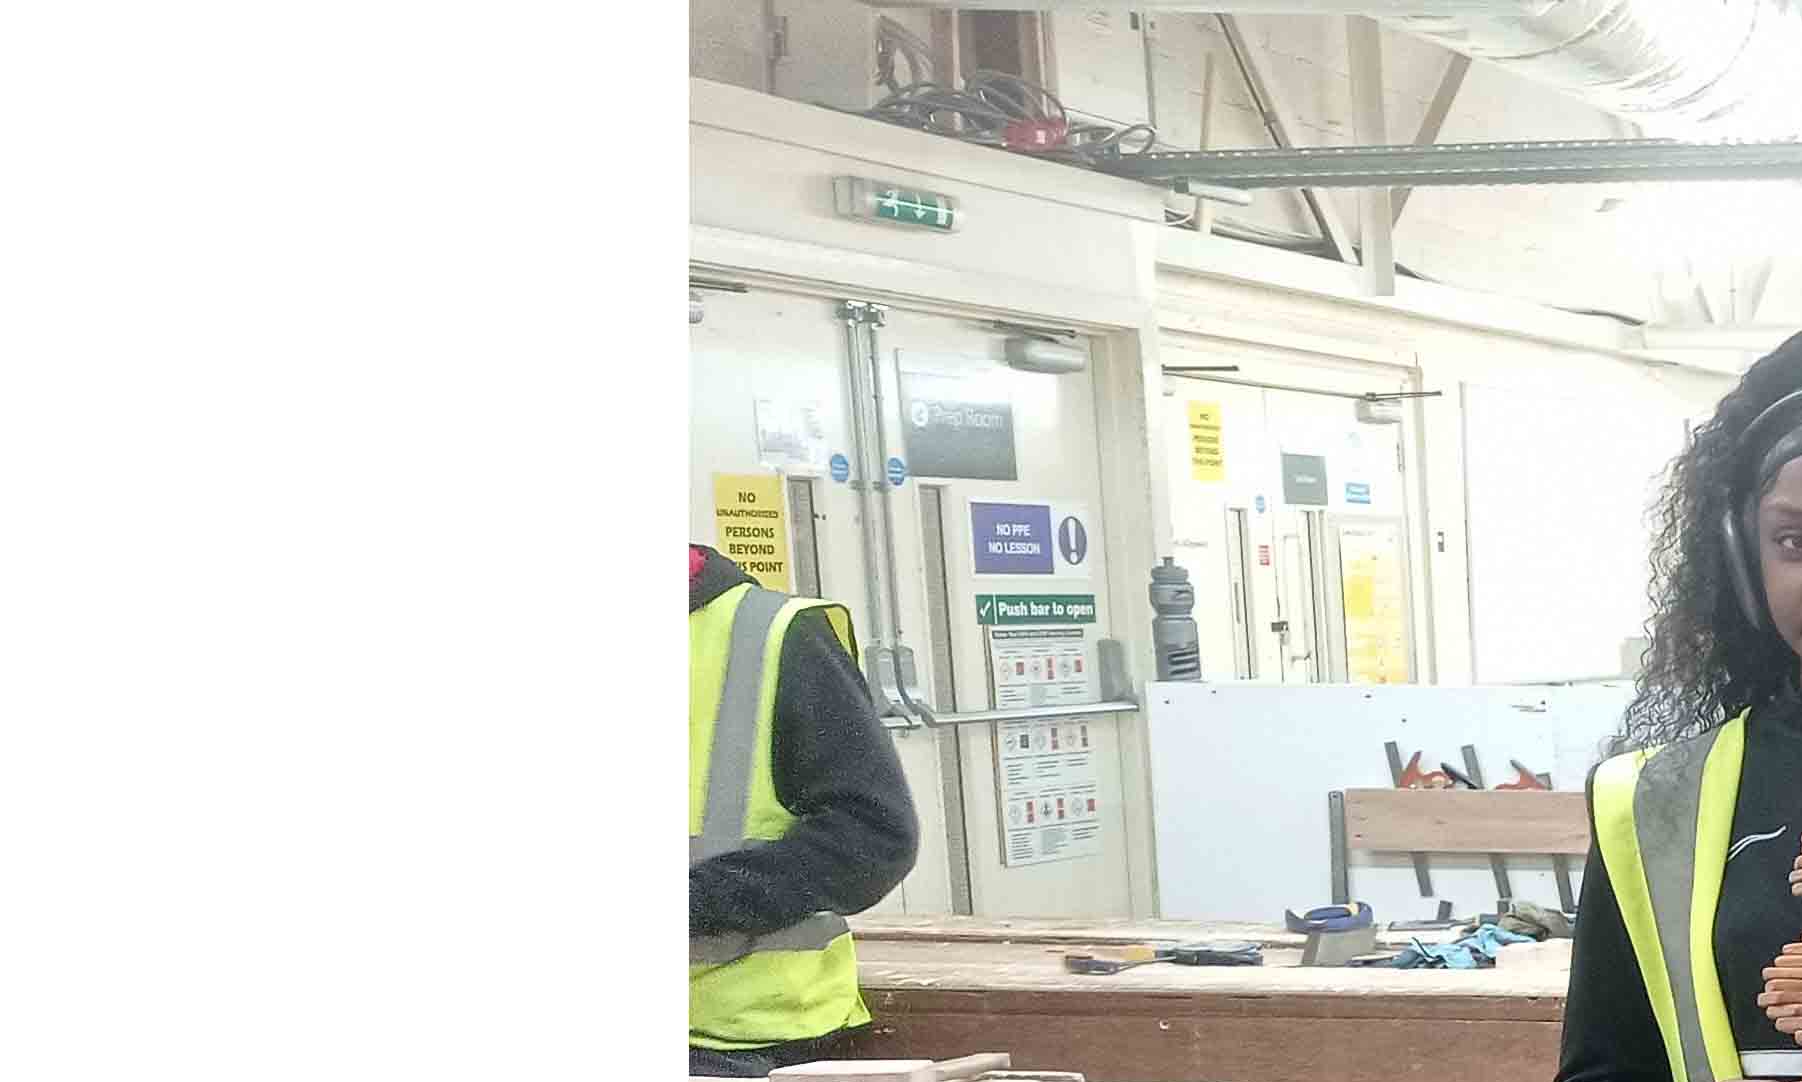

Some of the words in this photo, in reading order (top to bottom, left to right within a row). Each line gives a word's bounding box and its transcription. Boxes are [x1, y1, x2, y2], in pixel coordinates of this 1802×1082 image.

[738, 492, 756, 503] NO
[725, 526, 775, 538] PERSONS
[996, 523, 1011, 536] NO
[1012, 524, 1031, 537] PPE
[729, 544, 775, 554] BEYOND
[988, 541, 1003, 554] NO
[1004, 542, 1041, 555] LESSON
[750, 562, 783, 573] POINT
[998, 602, 1028, 617] Push
[1030, 601, 1050, 616] bar
[1052, 602, 1065, 616] to
[1066, 603, 1094, 620] open
